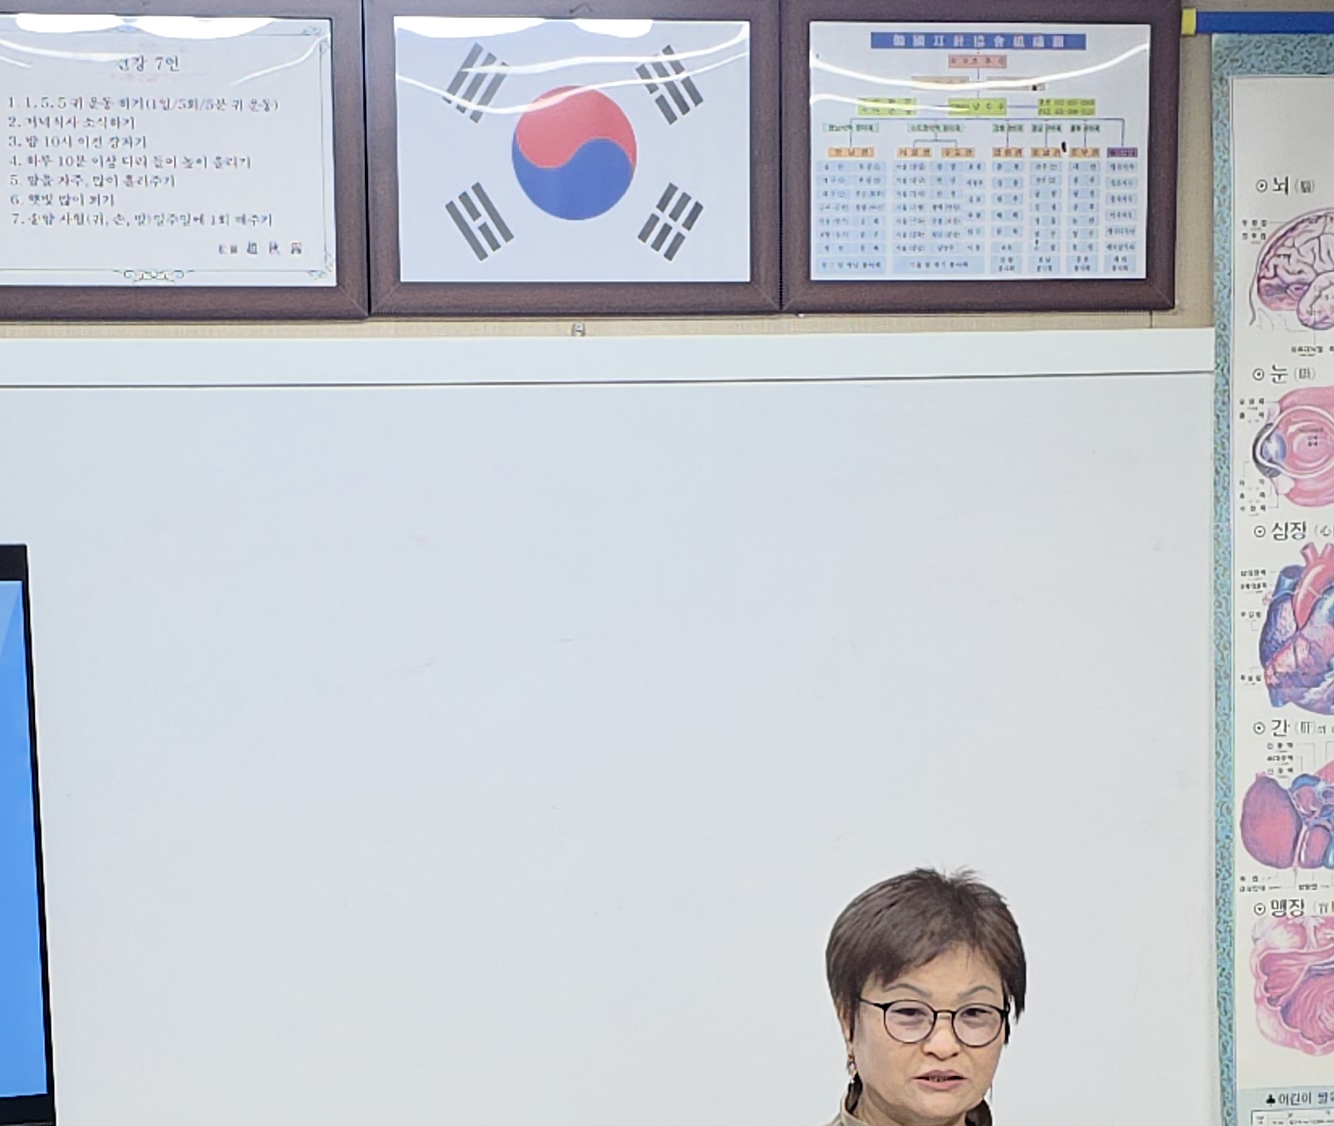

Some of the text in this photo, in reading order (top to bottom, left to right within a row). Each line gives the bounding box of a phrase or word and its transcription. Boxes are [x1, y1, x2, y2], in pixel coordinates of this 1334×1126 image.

[1272, 176, 1290, 195] 뇌
[1270, 364, 1289, 384] 눈
[1271, 521, 1307, 541] 심장
[1270, 718, 1290, 738] 간
[1270, 898, 1306, 918] 맹장
